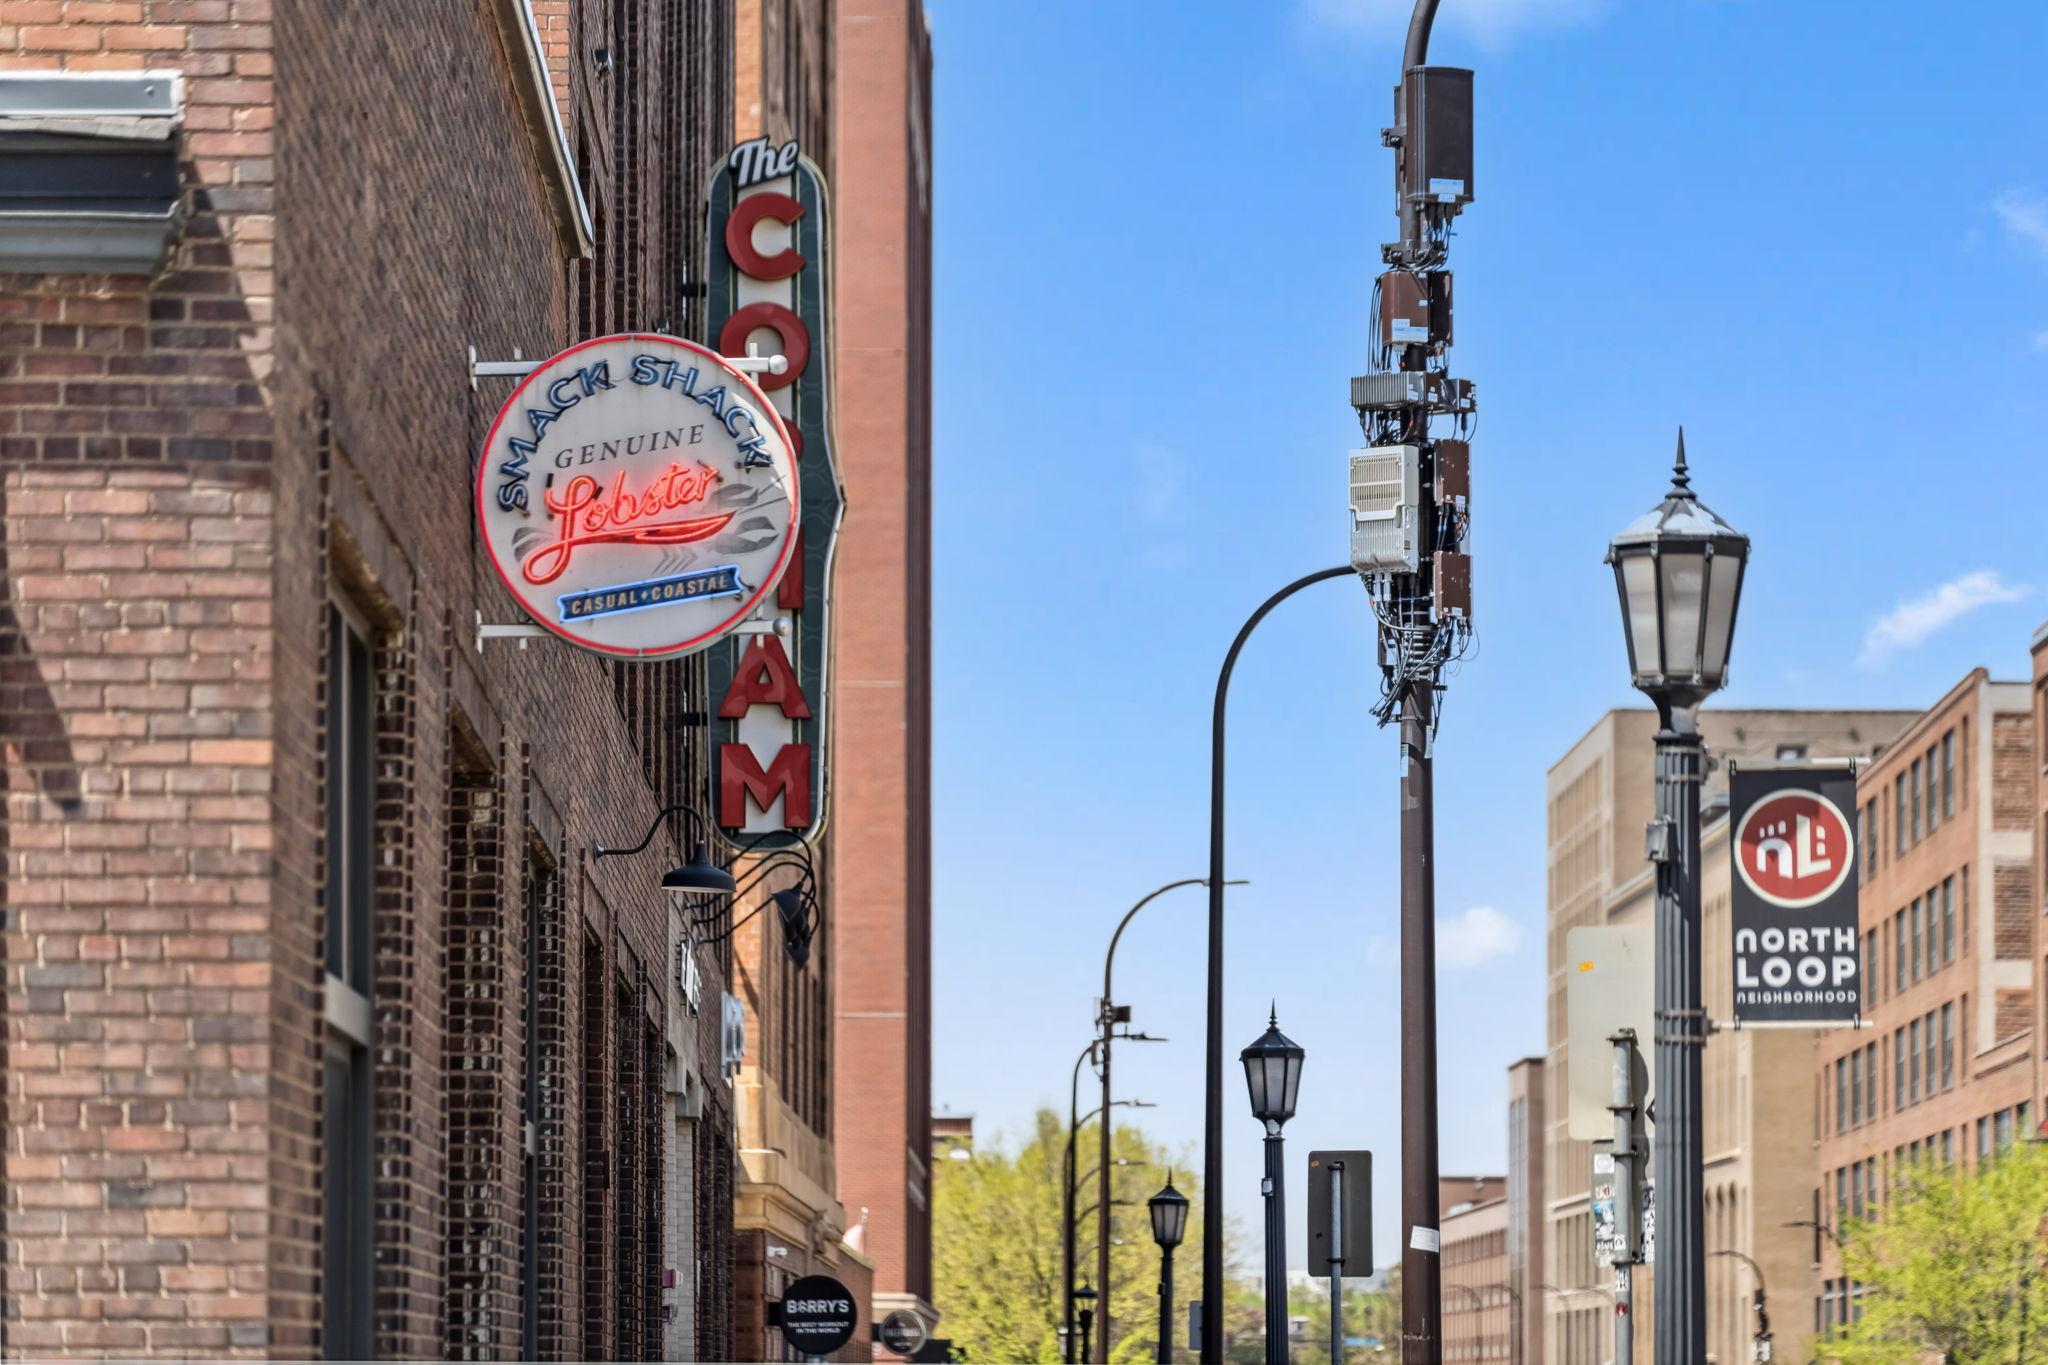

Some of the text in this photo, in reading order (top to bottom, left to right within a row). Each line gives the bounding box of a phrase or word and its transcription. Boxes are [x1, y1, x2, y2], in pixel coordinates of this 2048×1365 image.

[728, 136, 800, 190] The
[497, 354, 773, 513] SMACK SHACK
[554, 424, 706, 469] GENUINE
[523, 461, 736, 586] Lobster
[718, 191, 812, 829] COAM
[571, 576, 728, 616] CASUAL COASTAL
[1736, 956, 1856, 988] LOOP
